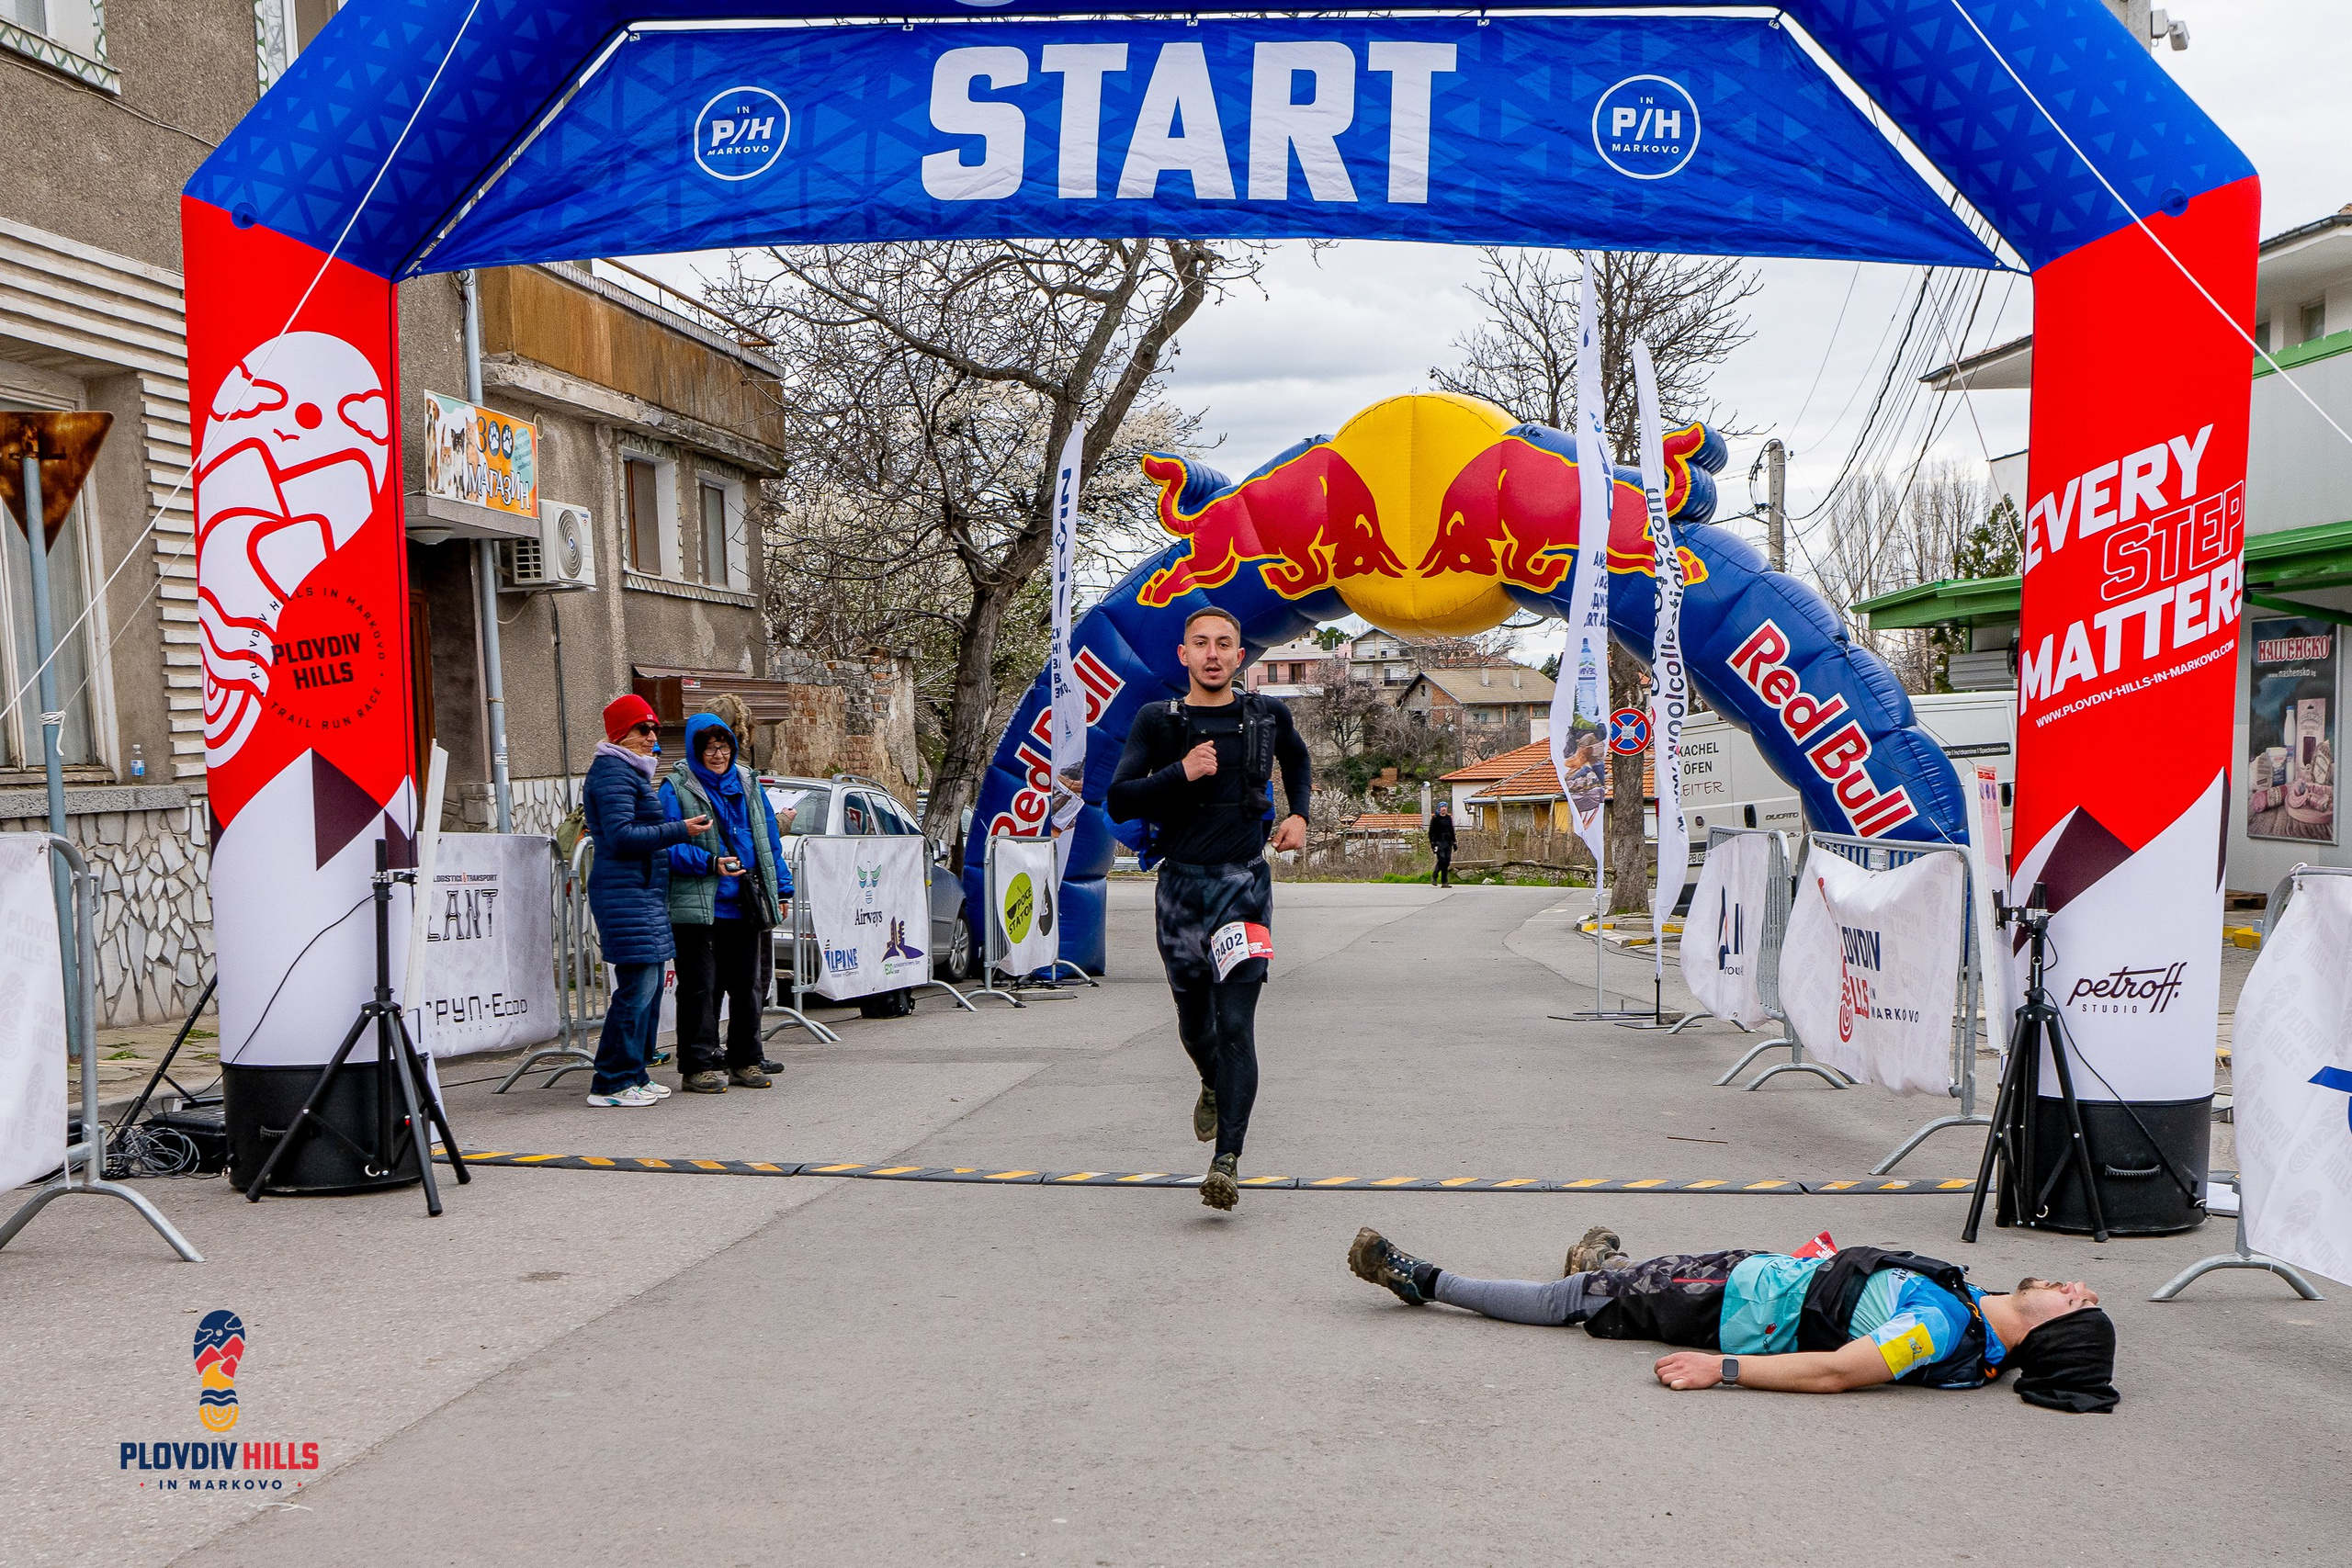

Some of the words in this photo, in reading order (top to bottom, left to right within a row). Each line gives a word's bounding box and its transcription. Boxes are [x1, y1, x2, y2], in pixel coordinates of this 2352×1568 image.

[736, 106, 750, 114] IN
[1640, 96, 1654, 105] IN
[711, 117, 775, 148] P/H
[922, 41, 1458, 204] START
[1611, 107, 1681, 141] P/H
[707, 145, 770, 156] MARKOVO
[1611, 143, 1680, 154] MARKOVO
[468, 462, 531, 510] МАГАЗИН
[2024, 423, 2214, 576] EVERY
[2100, 479, 2245, 602] STEP
[248, 613, 267, 680] PLOVDIV
[269, 587, 313, 611] HILLS
[322, 587, 338, 597] IN
[345, 596, 386, 660] MARKOVO
[2019, 548, 2245, 716] MATTERS
[270, 632, 361, 666] PLOVDIV
[2257, 636, 2330, 662] НАШЕНСКО
[292, 661, 355, 690] HILLS
[2035, 638, 2235, 728] WWW.PLOVDIV-HILLS-IN-MARKOVO.COM
[2268, 667, 2317, 678] www.nashensko.bg
[270, 701, 311, 728] TRAIL
[322, 716, 352, 729] RUN
[356, 687, 381, 718] RACE
[1727, 618, 1849, 746] Red
[1804, 719, 1919, 840] Bull
[1679, 741, 1719, 757] KACHEL
[1683, 761, 1713, 775] ÖFEN
[986, 740, 1052, 836] Red
[1679, 781, 1725, 796] EITER
[1765, 811, 1799, 821] DUCATO
[434, 874, 462, 883] LOGISTICS
[467, 874, 498, 882] TRANSPORT
[1016, 886, 1033, 911] POKE
[854, 908, 883, 927] Airways
[1215, 932, 1244, 964] 2402
[1840, 926, 1881, 972] OVDIV
[1849, 976, 1870, 1020] LLS
[2082, 1004, 2138, 1014] STUDIO
[1871, 1006, 1919, 1023] MARKOVO
